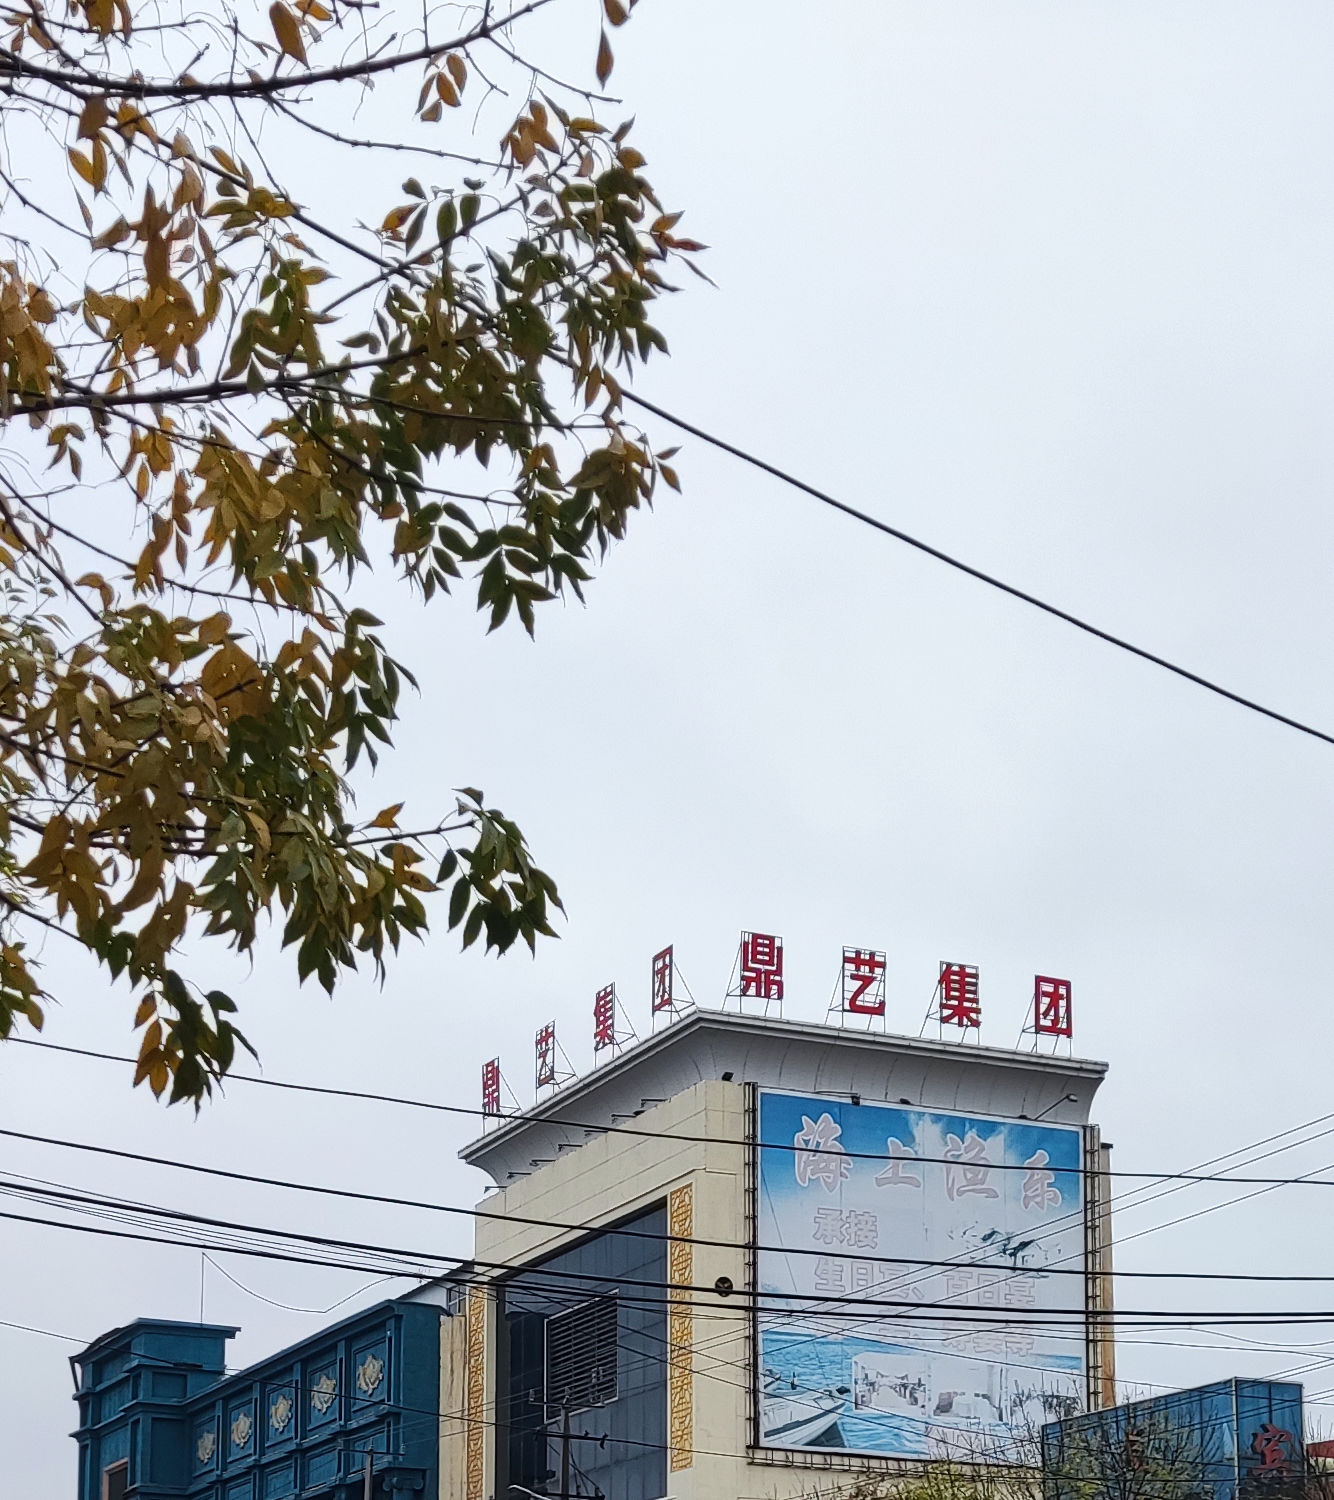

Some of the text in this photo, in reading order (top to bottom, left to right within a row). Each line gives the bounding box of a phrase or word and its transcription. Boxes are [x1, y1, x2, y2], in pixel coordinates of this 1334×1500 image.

[482, 944, 673, 1114] 鼎艺集团
[741, 933, 1072, 1038] 鼎艺集团
[793, 1112, 1062, 1212] 海上渔乐
[813, 1207, 879, 1250] 承接
